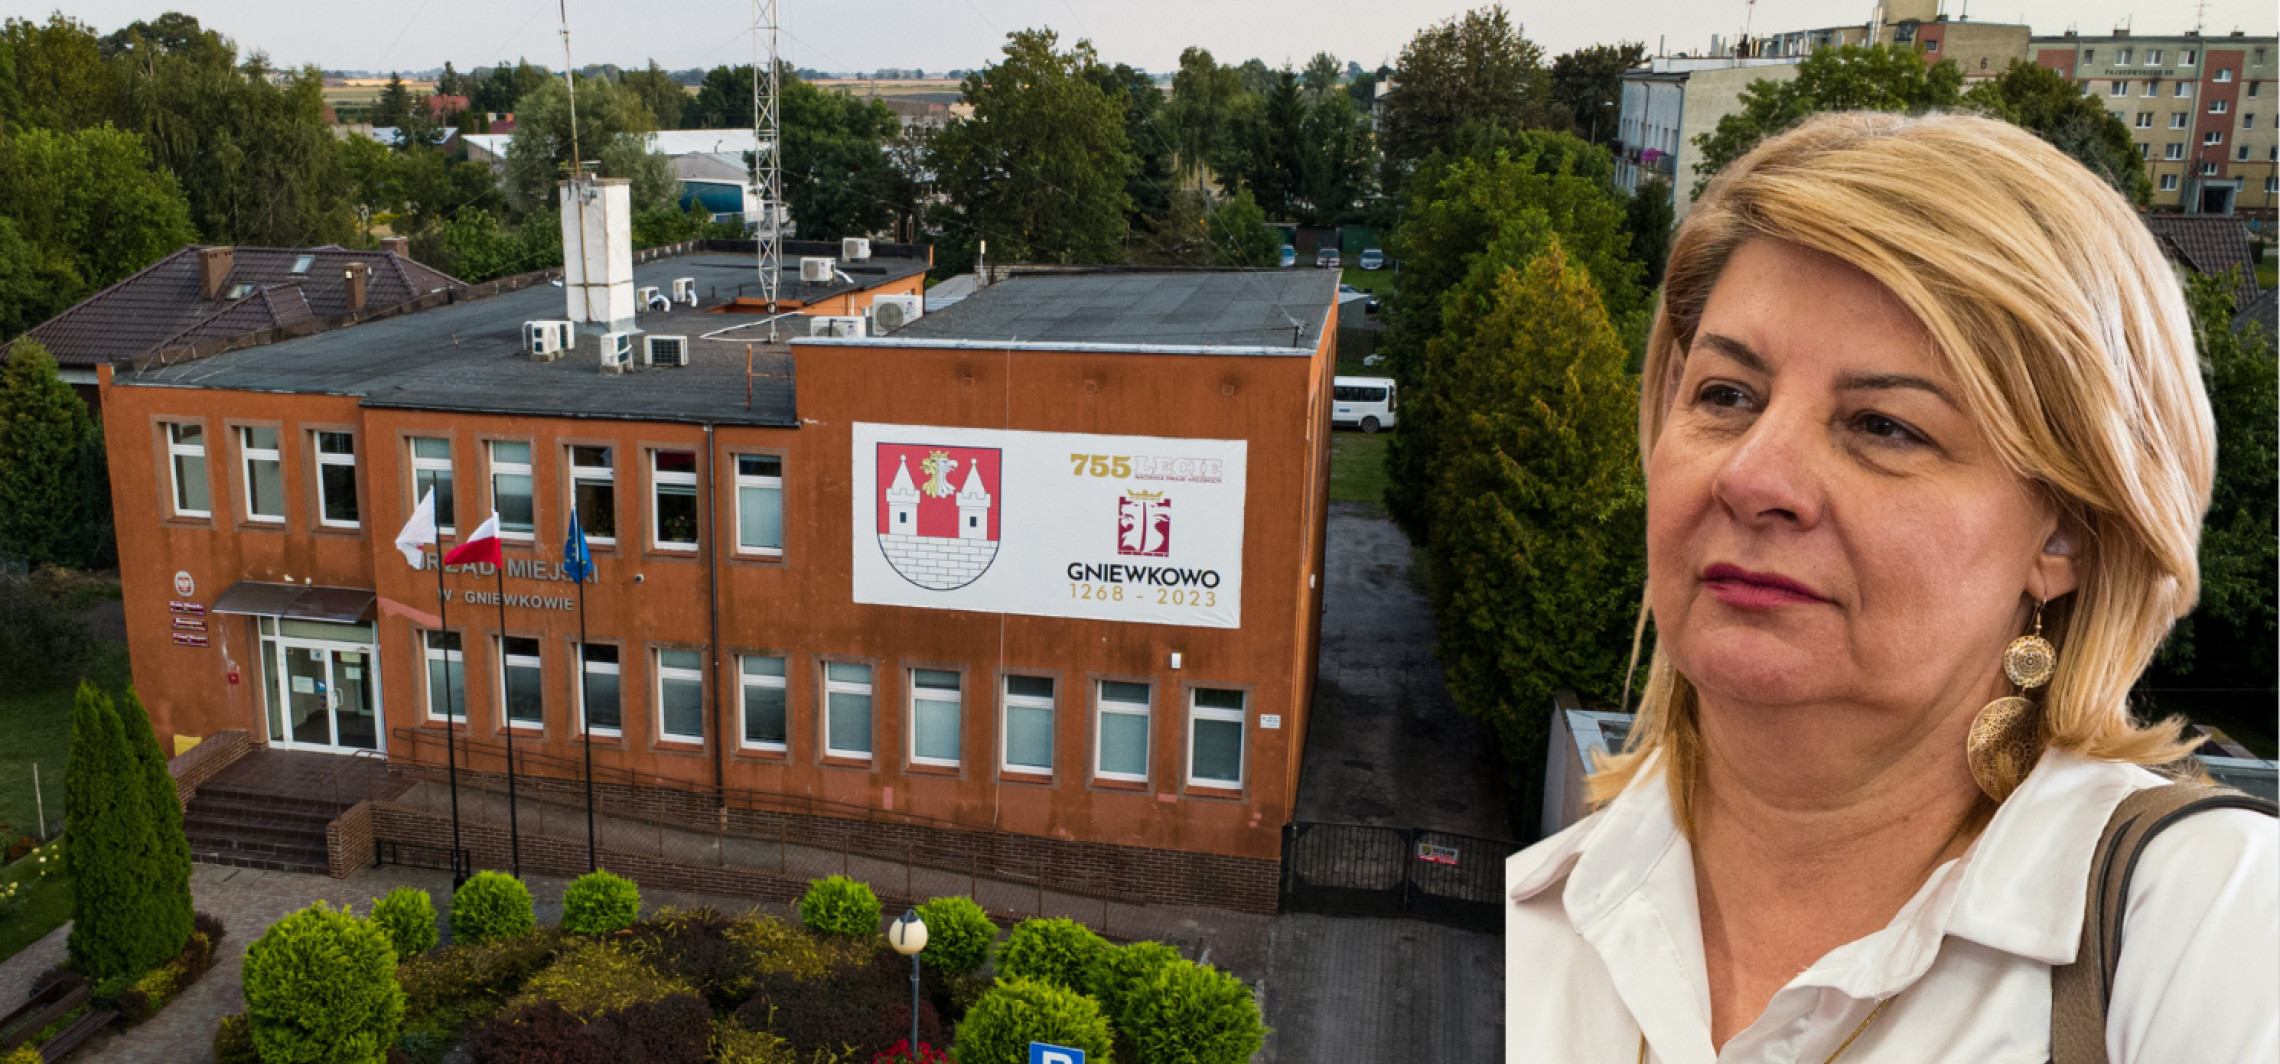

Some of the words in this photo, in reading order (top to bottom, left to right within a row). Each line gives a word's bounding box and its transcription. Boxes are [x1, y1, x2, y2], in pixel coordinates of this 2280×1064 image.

[1980, 57, 1988, 70] 6
[1070, 453, 1132, 479] 755
[1134, 455, 1224, 477] LECIE
[1067, 562, 1221, 589] GNIEWKOWO
[464, 590, 575, 611] GNIEWKOWIE
[1069, 582, 1123, 602] 1268
[1156, 588, 1216, 607] 2023
